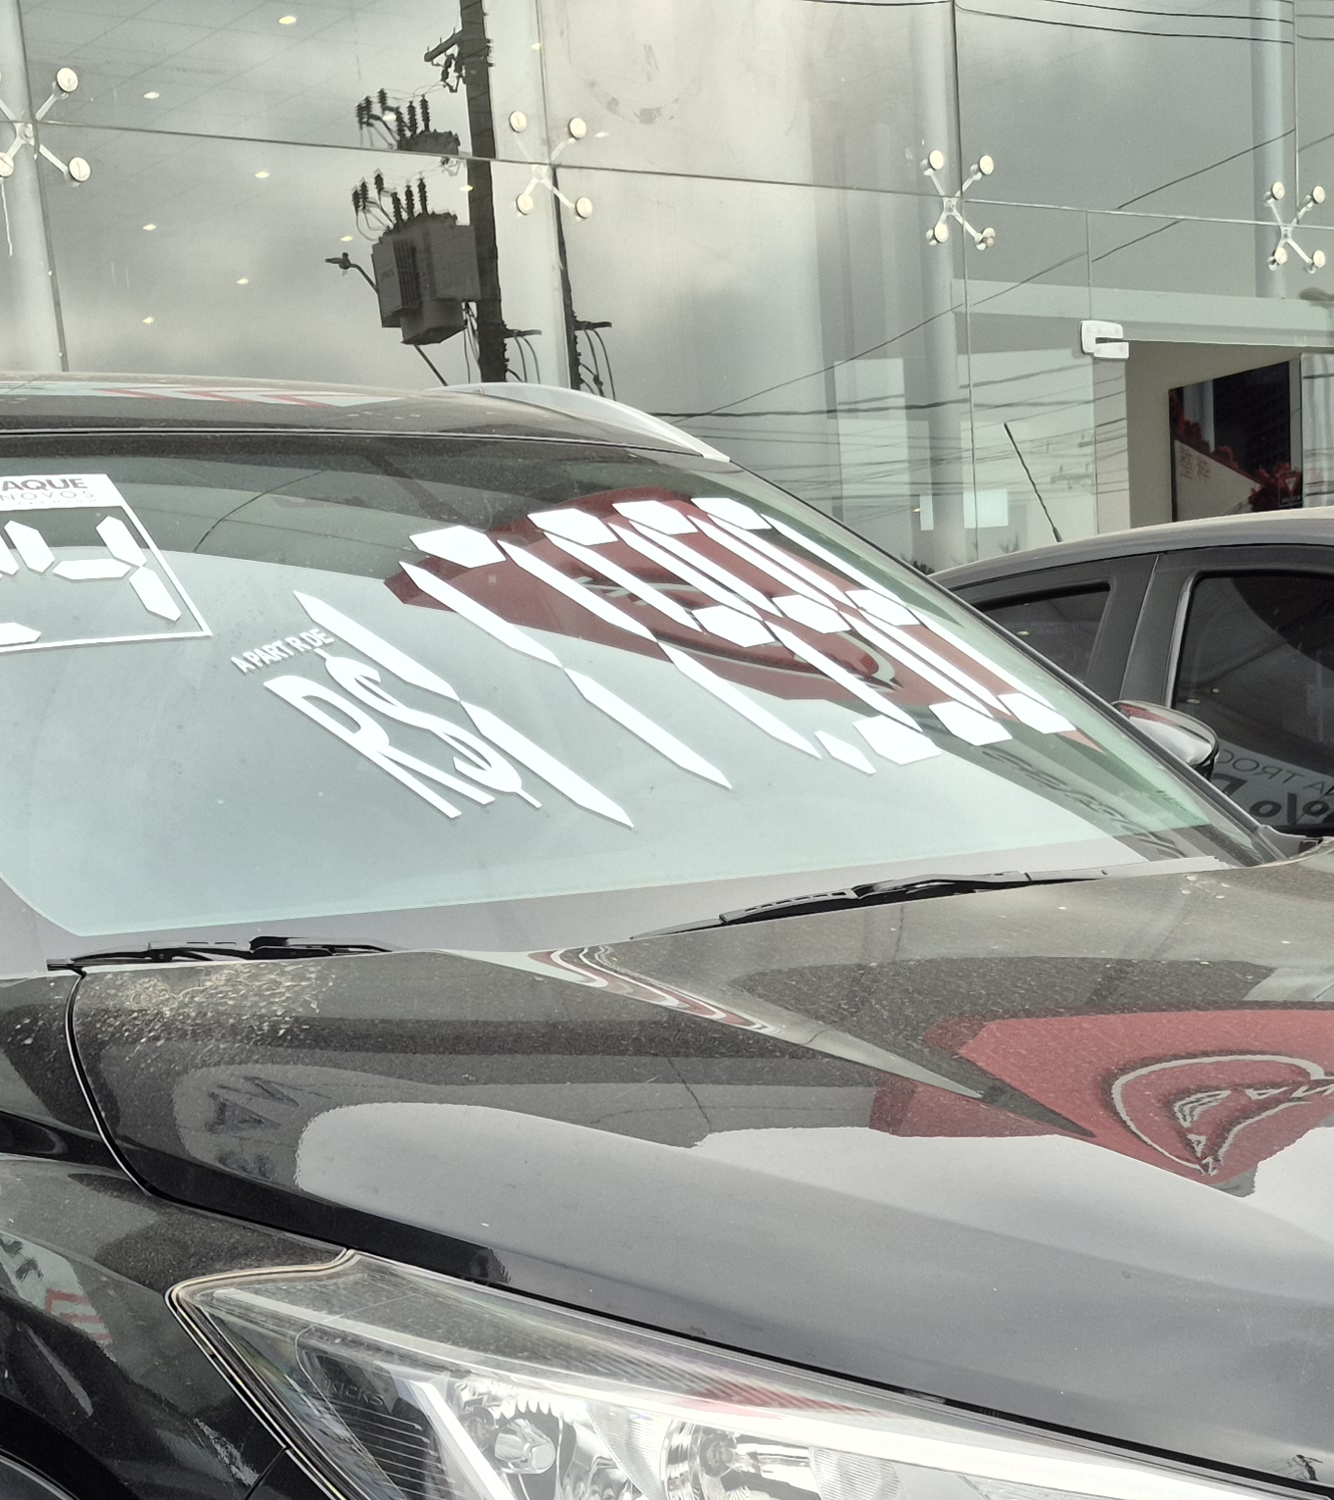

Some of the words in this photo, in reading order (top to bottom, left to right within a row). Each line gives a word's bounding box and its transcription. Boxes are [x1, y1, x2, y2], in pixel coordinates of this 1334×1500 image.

[299, 628, 335, 648] DE
[242, 637, 312, 667] PARTR
[230, 656, 256, 673] A
